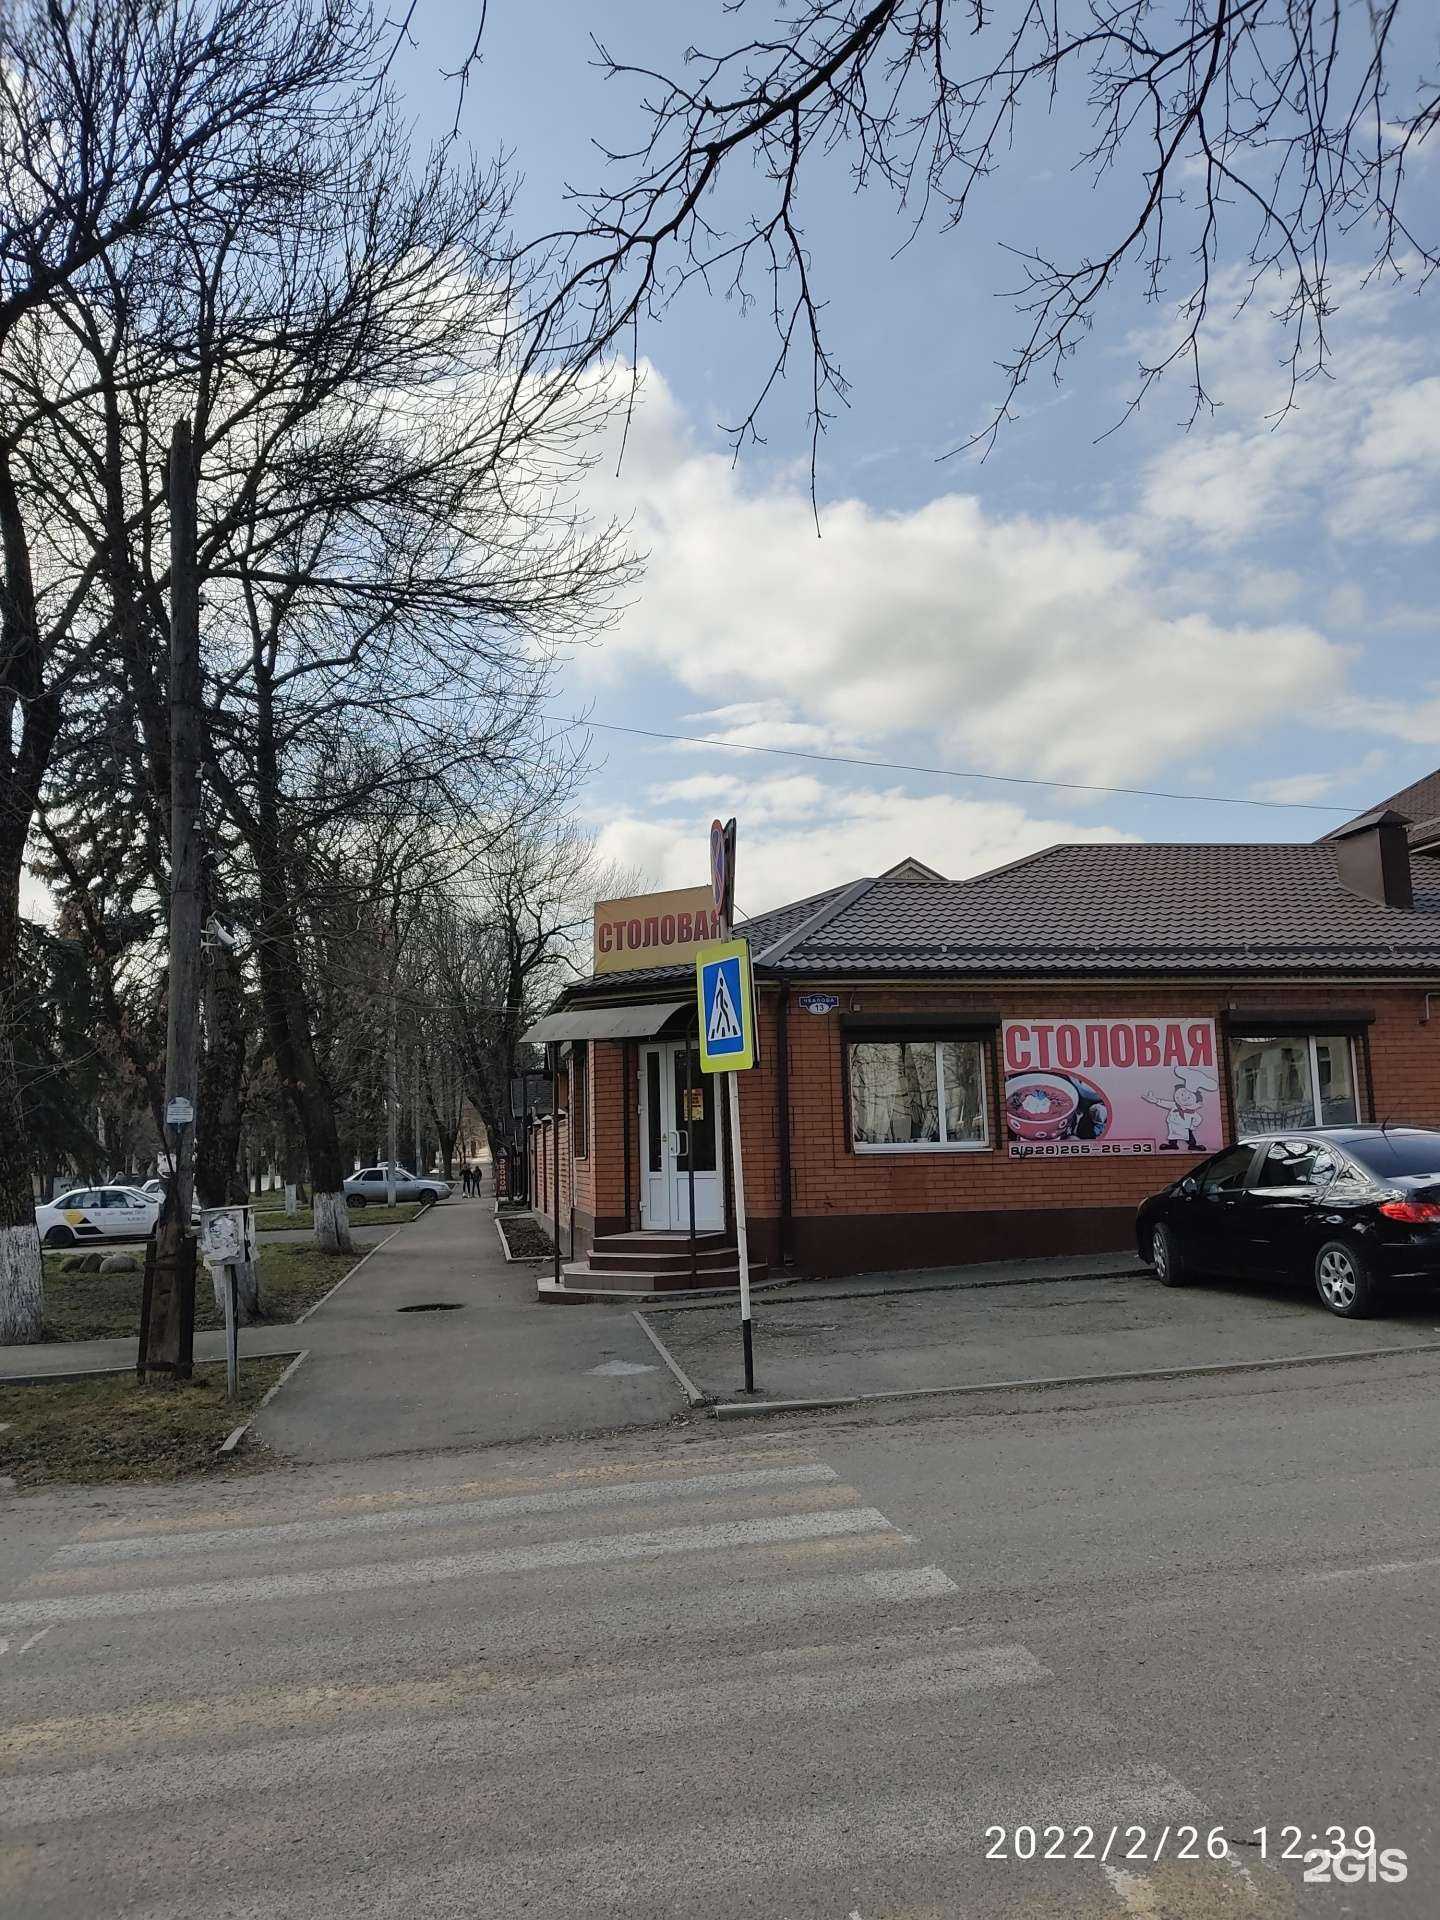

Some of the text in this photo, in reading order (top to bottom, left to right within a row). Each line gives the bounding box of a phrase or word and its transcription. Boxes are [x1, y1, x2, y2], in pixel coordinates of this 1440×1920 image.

[598, 910, 721, 953] СТОЛОВАЯ
[815, 1004, 825, 1012] 13
[1005, 1023, 1213, 1070] СТОЛОВАЯ
[1010, 1143, 1153, 1157] 8(928)265-26-93
